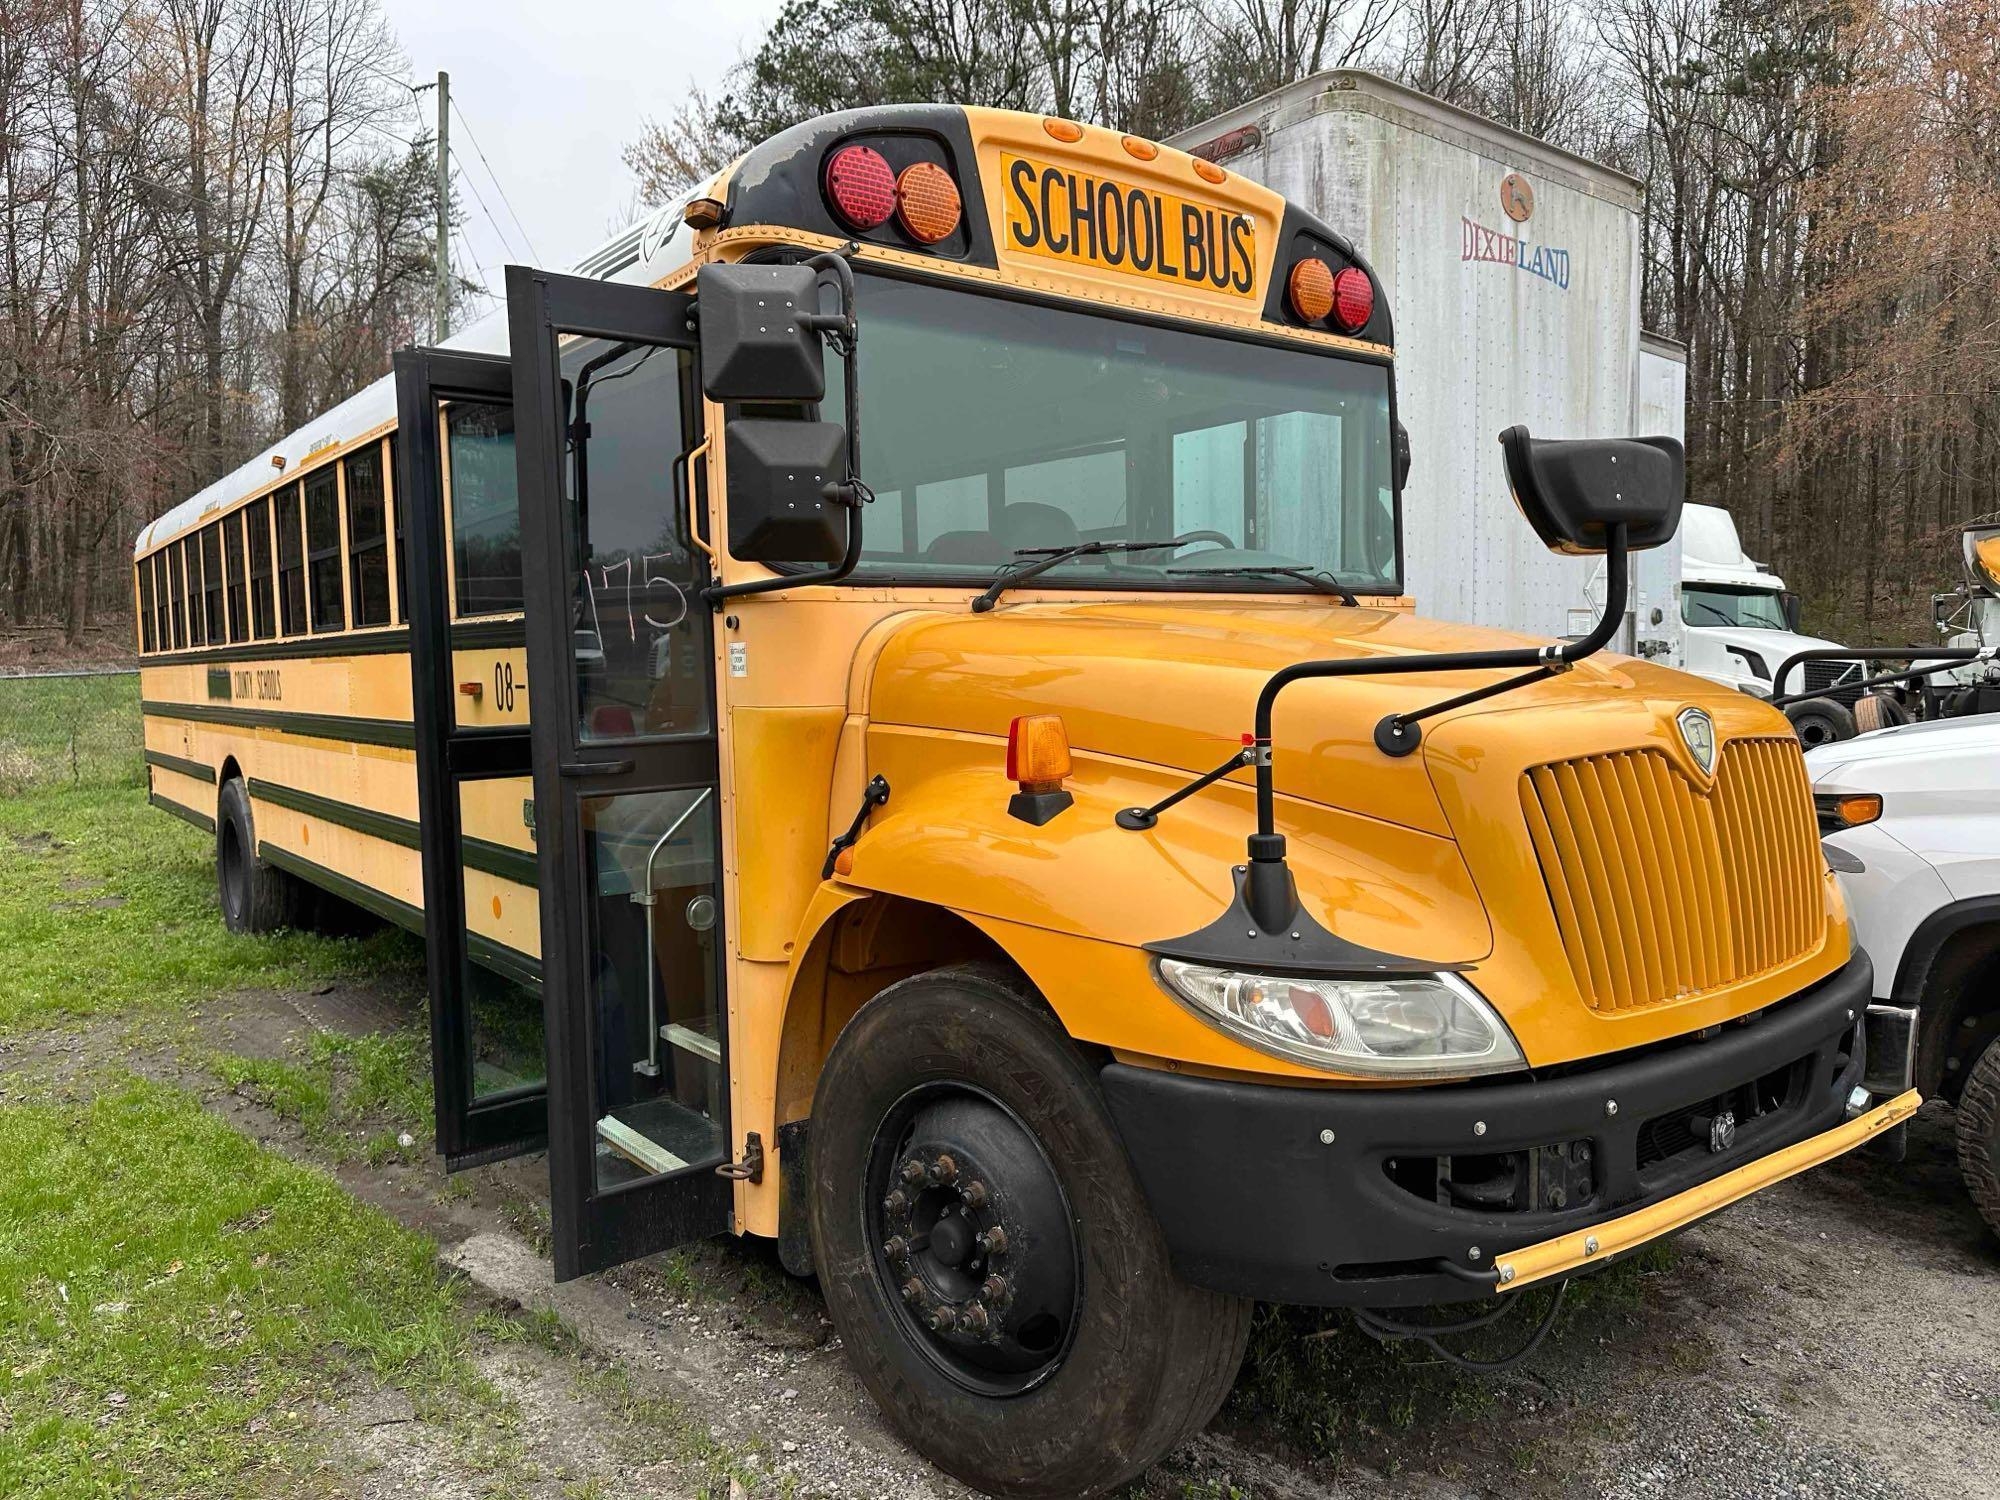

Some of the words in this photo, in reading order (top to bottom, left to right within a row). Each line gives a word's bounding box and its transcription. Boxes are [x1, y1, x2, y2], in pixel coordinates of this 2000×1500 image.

[1217, 138, 1243, 156] Dane
[1010, 159, 1179, 277] SCHOOL
[1181, 203, 1253, 293] BUS
[584, 552, 687, 652] 175
[234, 671, 254, 700] COUNTY
[257, 670, 282, 701] SCHOOLS
